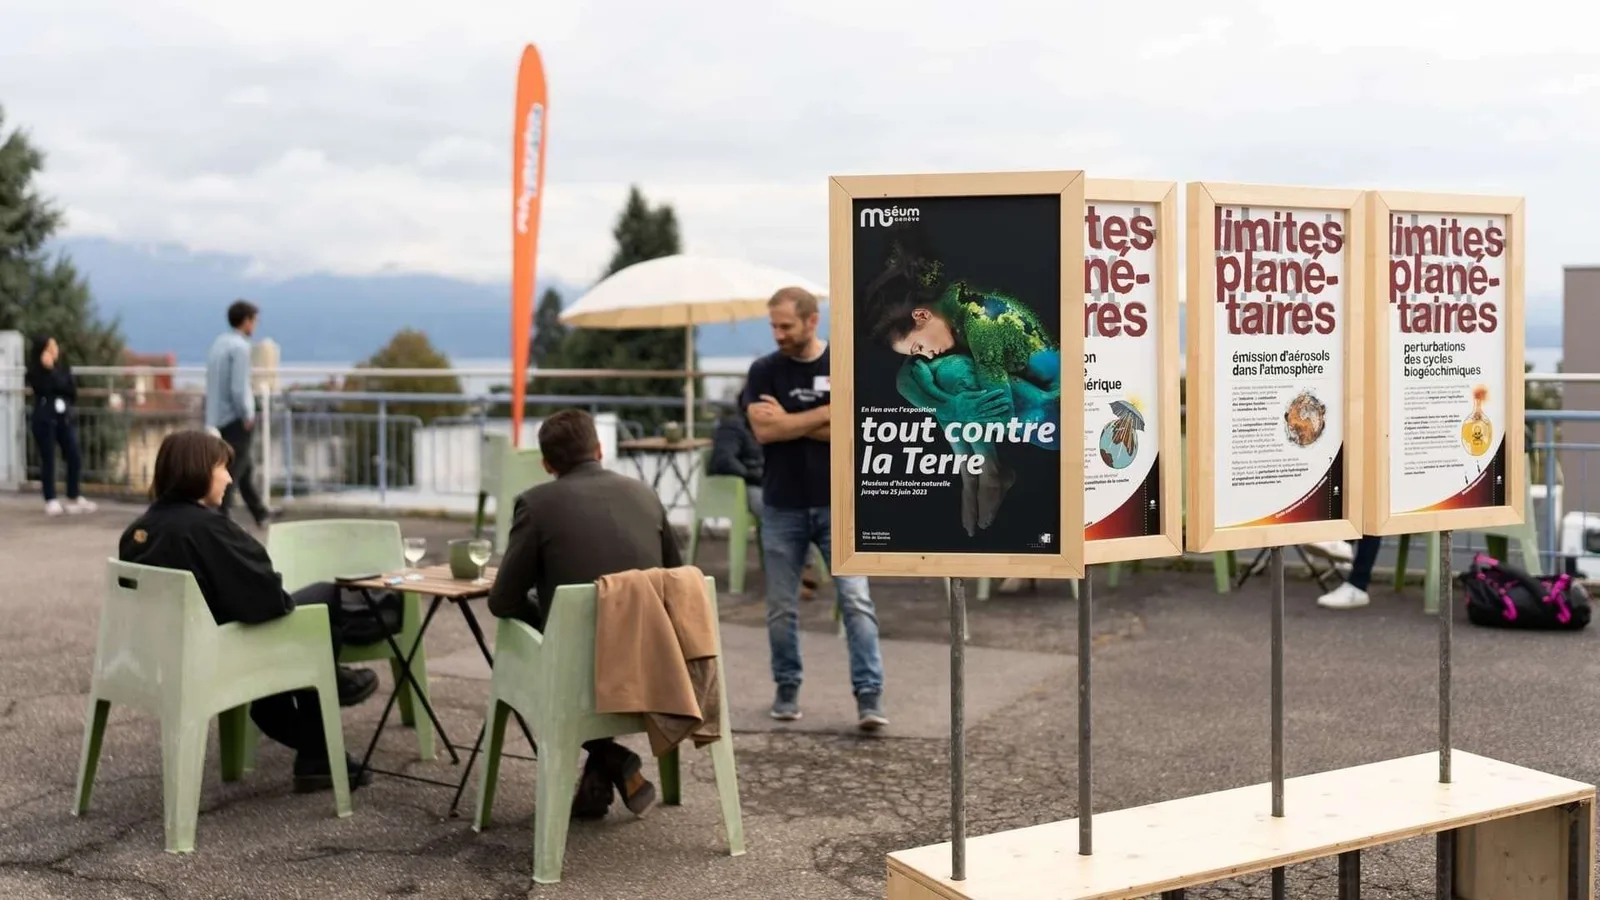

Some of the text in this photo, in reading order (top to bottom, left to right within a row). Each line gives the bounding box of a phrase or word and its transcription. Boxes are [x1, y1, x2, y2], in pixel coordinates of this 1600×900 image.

[1214, 206, 1343, 254] limites
[1216, 248, 1339, 303] plané-
[1389, 252, 1500, 303] plané-
[1225, 294, 1336, 335] taires
[1397, 295, 1498, 334] taires
[1232, 349, 1330, 363] émission d'aérosols
[1403, 341, 1466, 355] perturbations
[1403, 353, 1453, 367] des cycles
[1232, 362, 1324, 378] dans l'atmosphère
[1403, 364, 1481, 380] biogéochimiques
[1084, 377, 1122, 393] érique
[899, 406, 937, 414] l'exposition
[861, 417, 1056, 443] tout contre
[861, 445, 985, 475] la Terre
[861, 479, 889, 487] Muséum
[860, 488, 889, 497] jusqu'au
[898, 488, 911, 497] juin
[911, 488, 928, 496] 2023
